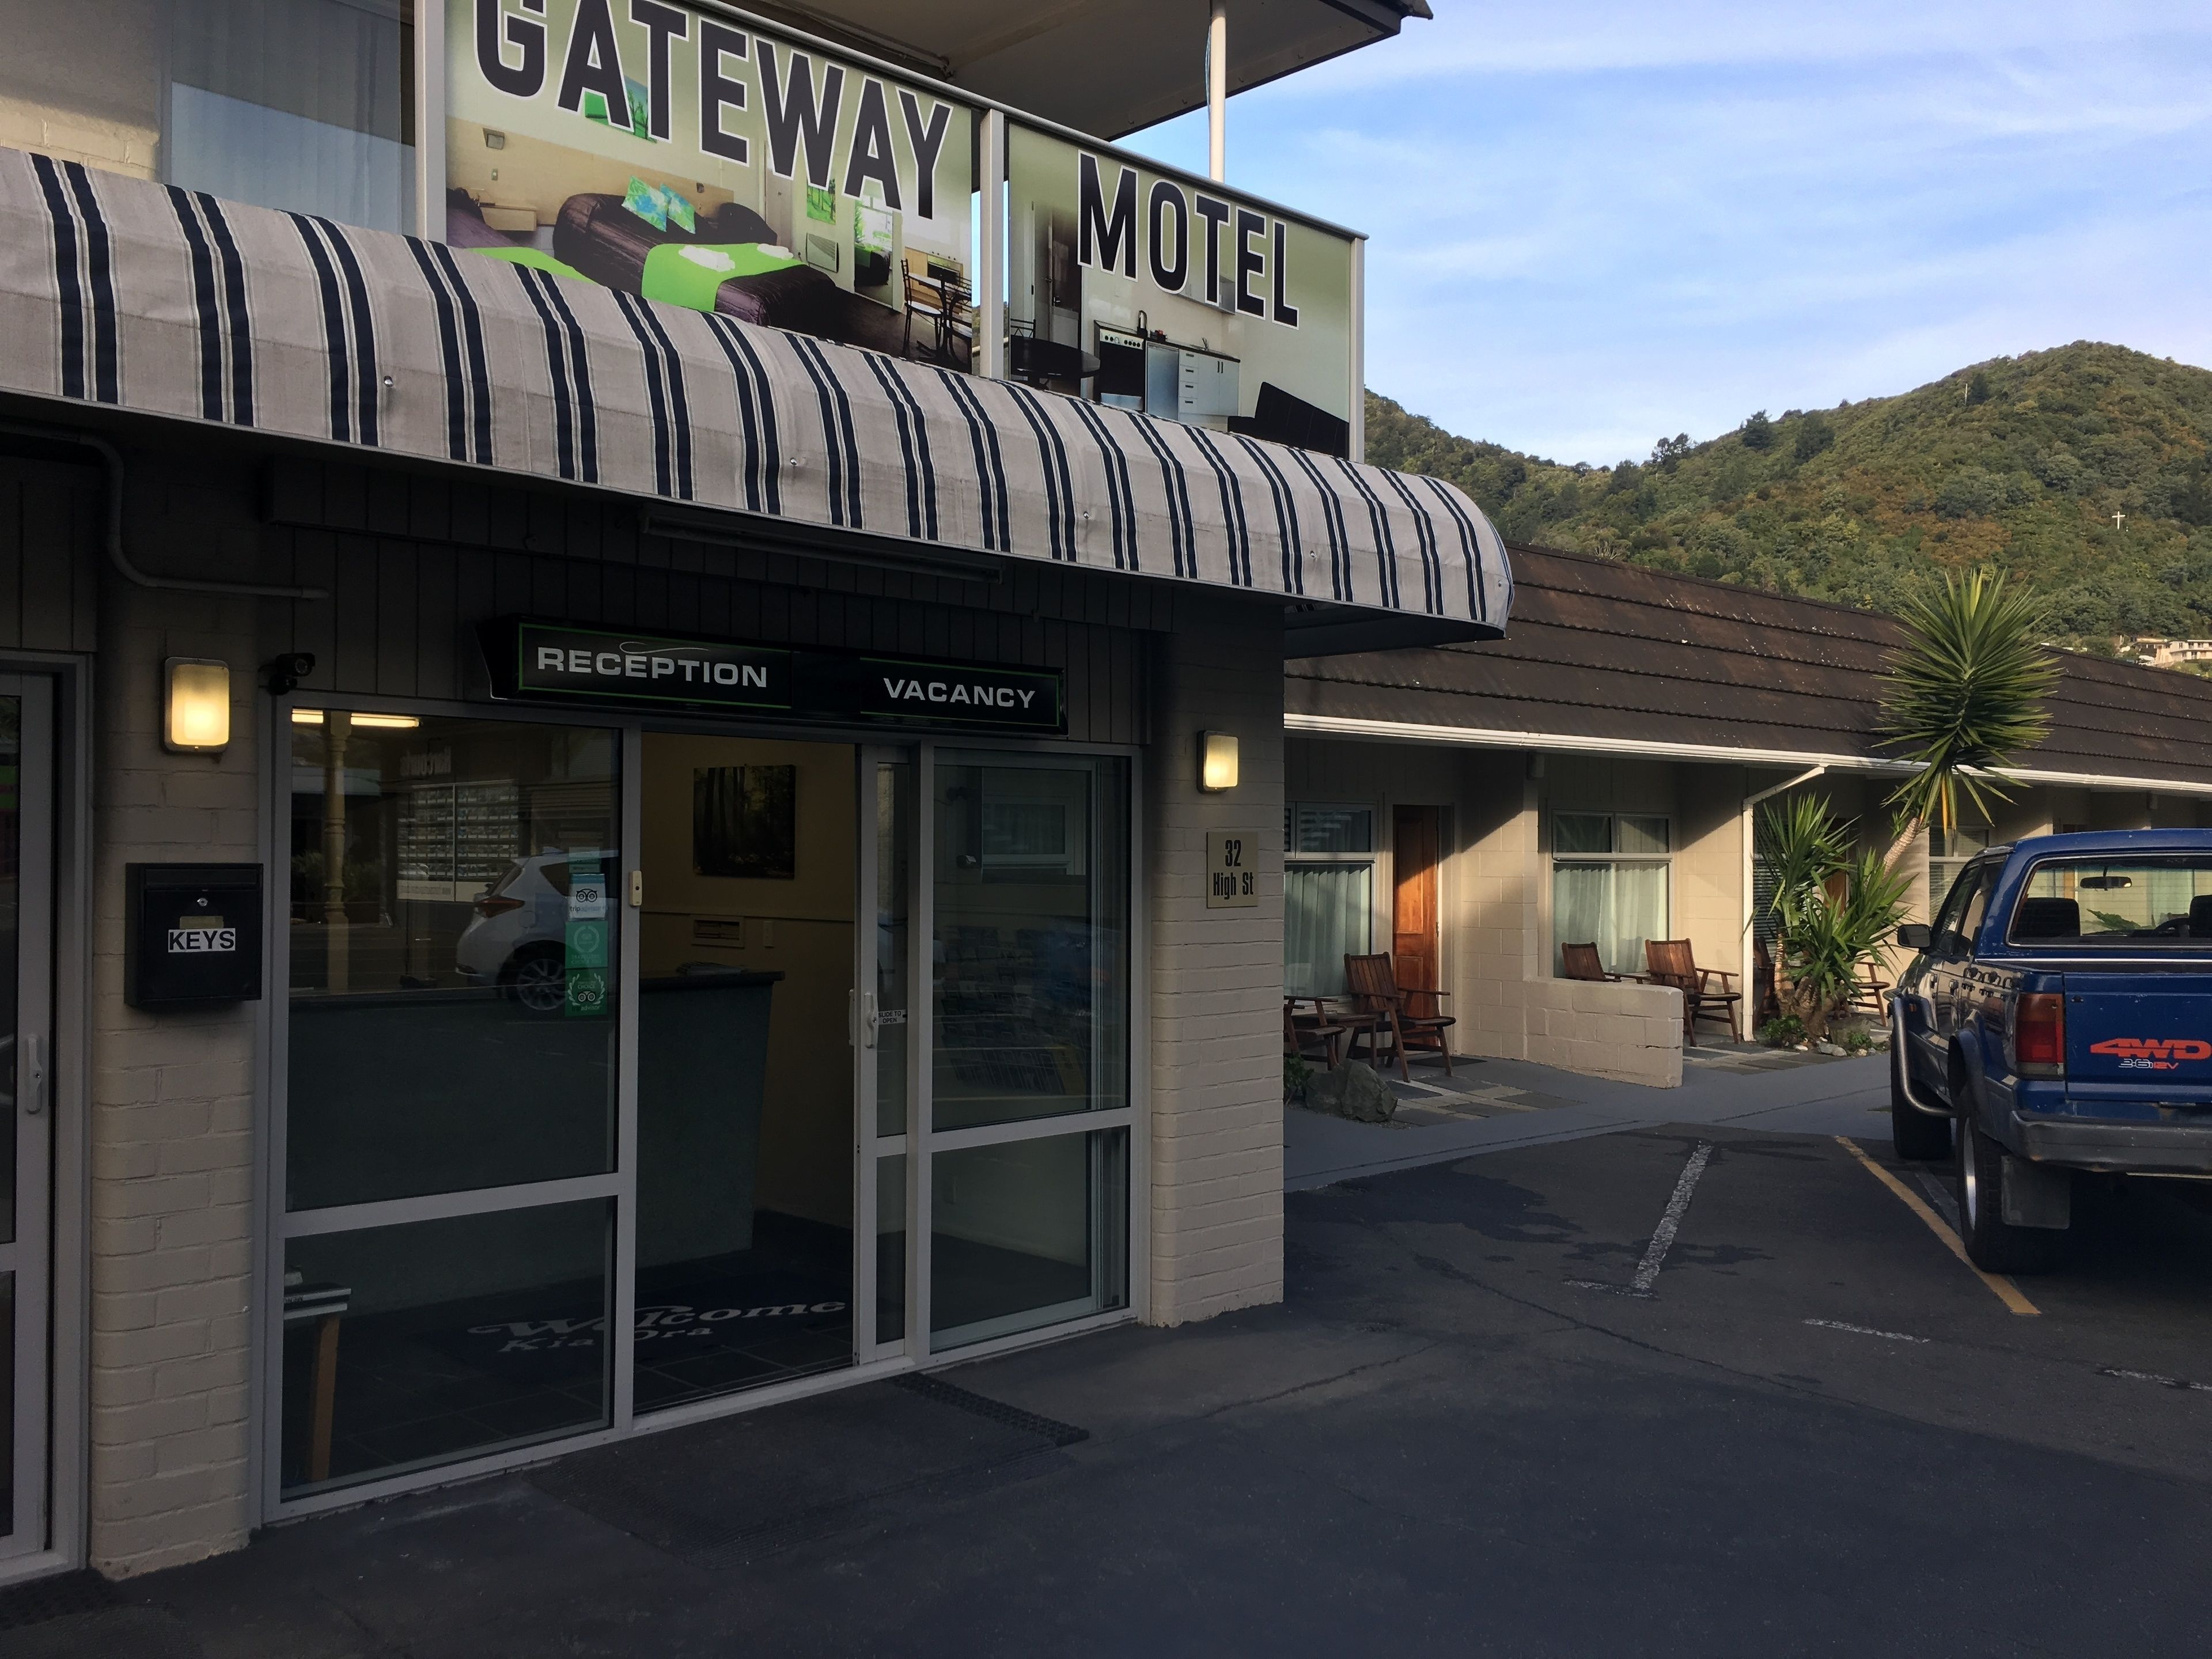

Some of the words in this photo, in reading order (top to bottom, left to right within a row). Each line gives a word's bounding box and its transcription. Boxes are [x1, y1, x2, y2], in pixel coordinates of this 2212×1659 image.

[475, 0, 955, 221] GATEWAY
[1078, 149, 1299, 330] MOTEL
[537, 647, 767, 687] RECEPTION
[883, 677, 1036, 708] VACANCY
[1225, 839, 1241, 867] 32
[1213, 872, 1237, 900] High
[1242, 872, 1254, 895] St
[169, 930, 235, 950] KEYS
[2090, 1038, 2212, 1060] 4WD
